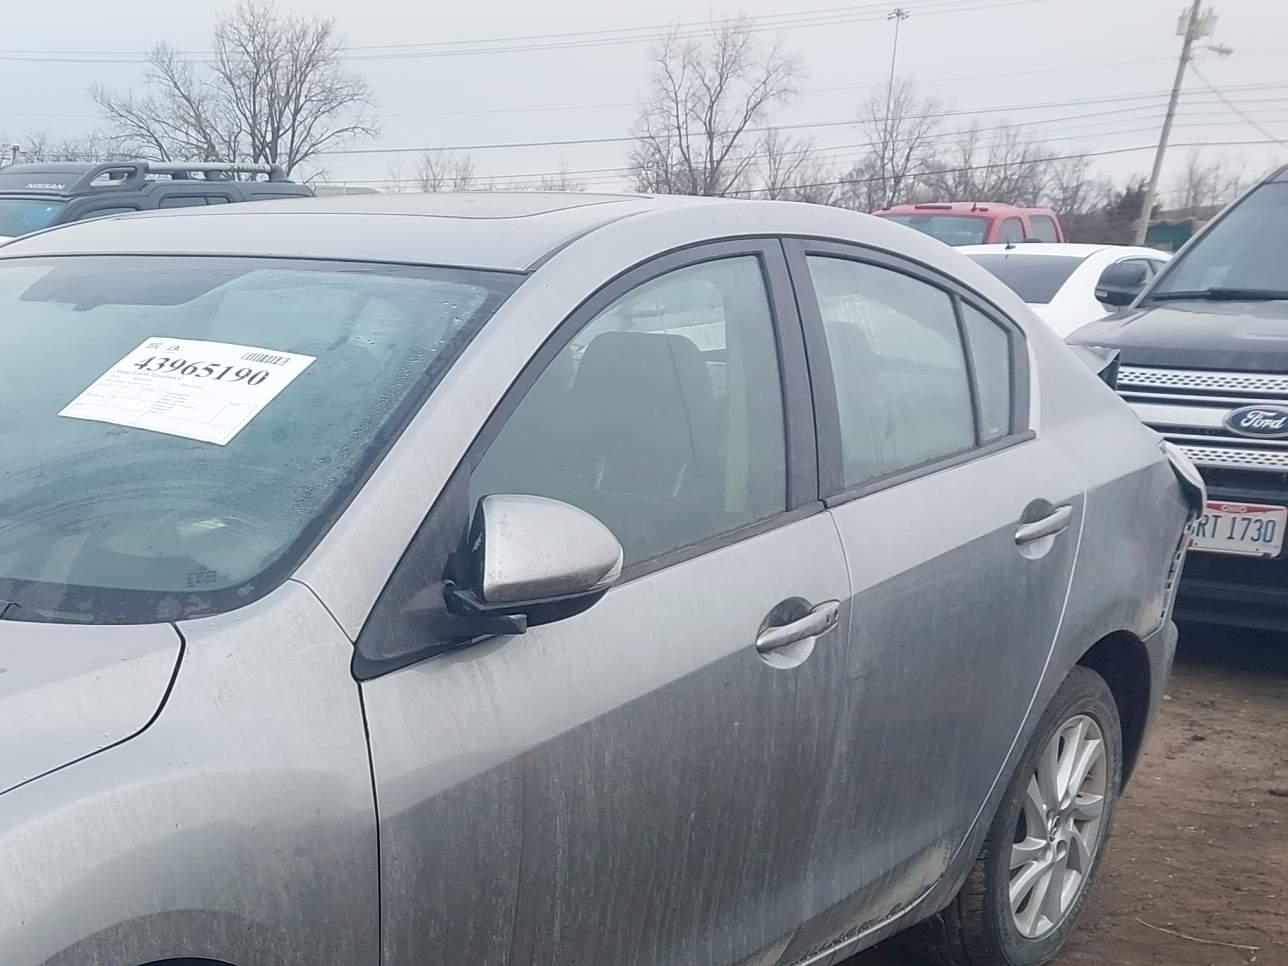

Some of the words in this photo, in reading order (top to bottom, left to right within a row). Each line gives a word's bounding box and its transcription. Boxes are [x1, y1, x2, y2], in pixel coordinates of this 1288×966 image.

[133, 355, 270, 386] 43965190
[1241, 410, 1287, 429] Ford
[1221, 504, 1248, 513] OO
[1191, 514, 1222, 538] RT
[1226, 516, 1276, 543] 1730
